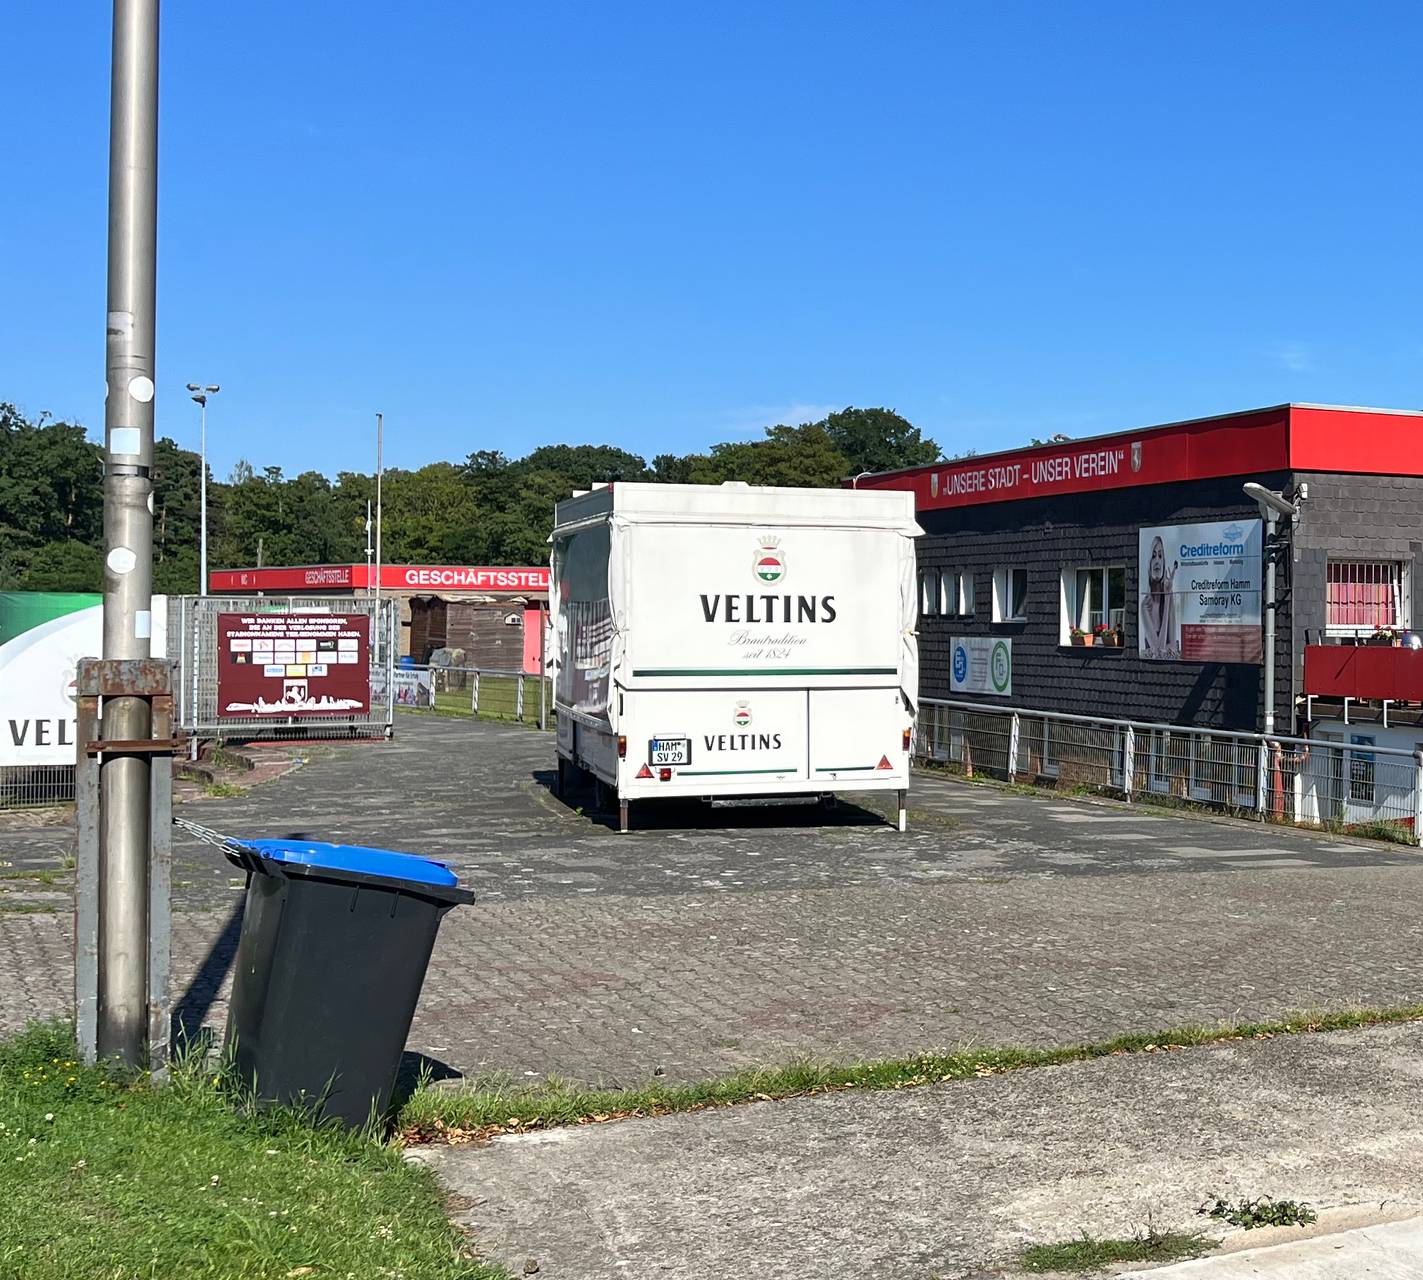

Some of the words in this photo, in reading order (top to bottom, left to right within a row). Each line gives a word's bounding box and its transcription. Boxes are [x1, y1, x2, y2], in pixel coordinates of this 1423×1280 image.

[987, 465, 1021, 489] STADT
[1031, 457, 1071, 484] UNSER
[1180, 542, 1244, 557] Creditreform
[304, 568, 350, 584] GESCHÄFTSSTELLE
[405, 568, 550, 586] GESCHÄFTSSTEL
[1190, 580, 1230, 591] Creditreform
[1230, 579, 1251, 589] Hamm
[1231, 593, 1242, 605] KG
[699, 594, 837, 623] VELTINS
[727, 629, 808, 646] Brautradition
[743, 649, 763, 659] seit
[765, 648, 792, 659] 1824
[658, 742, 677, 752] HAM
[704, 733, 782, 751] VELTINS
[657, 752, 669, 763] SV
[671, 751, 683, 762] 29
